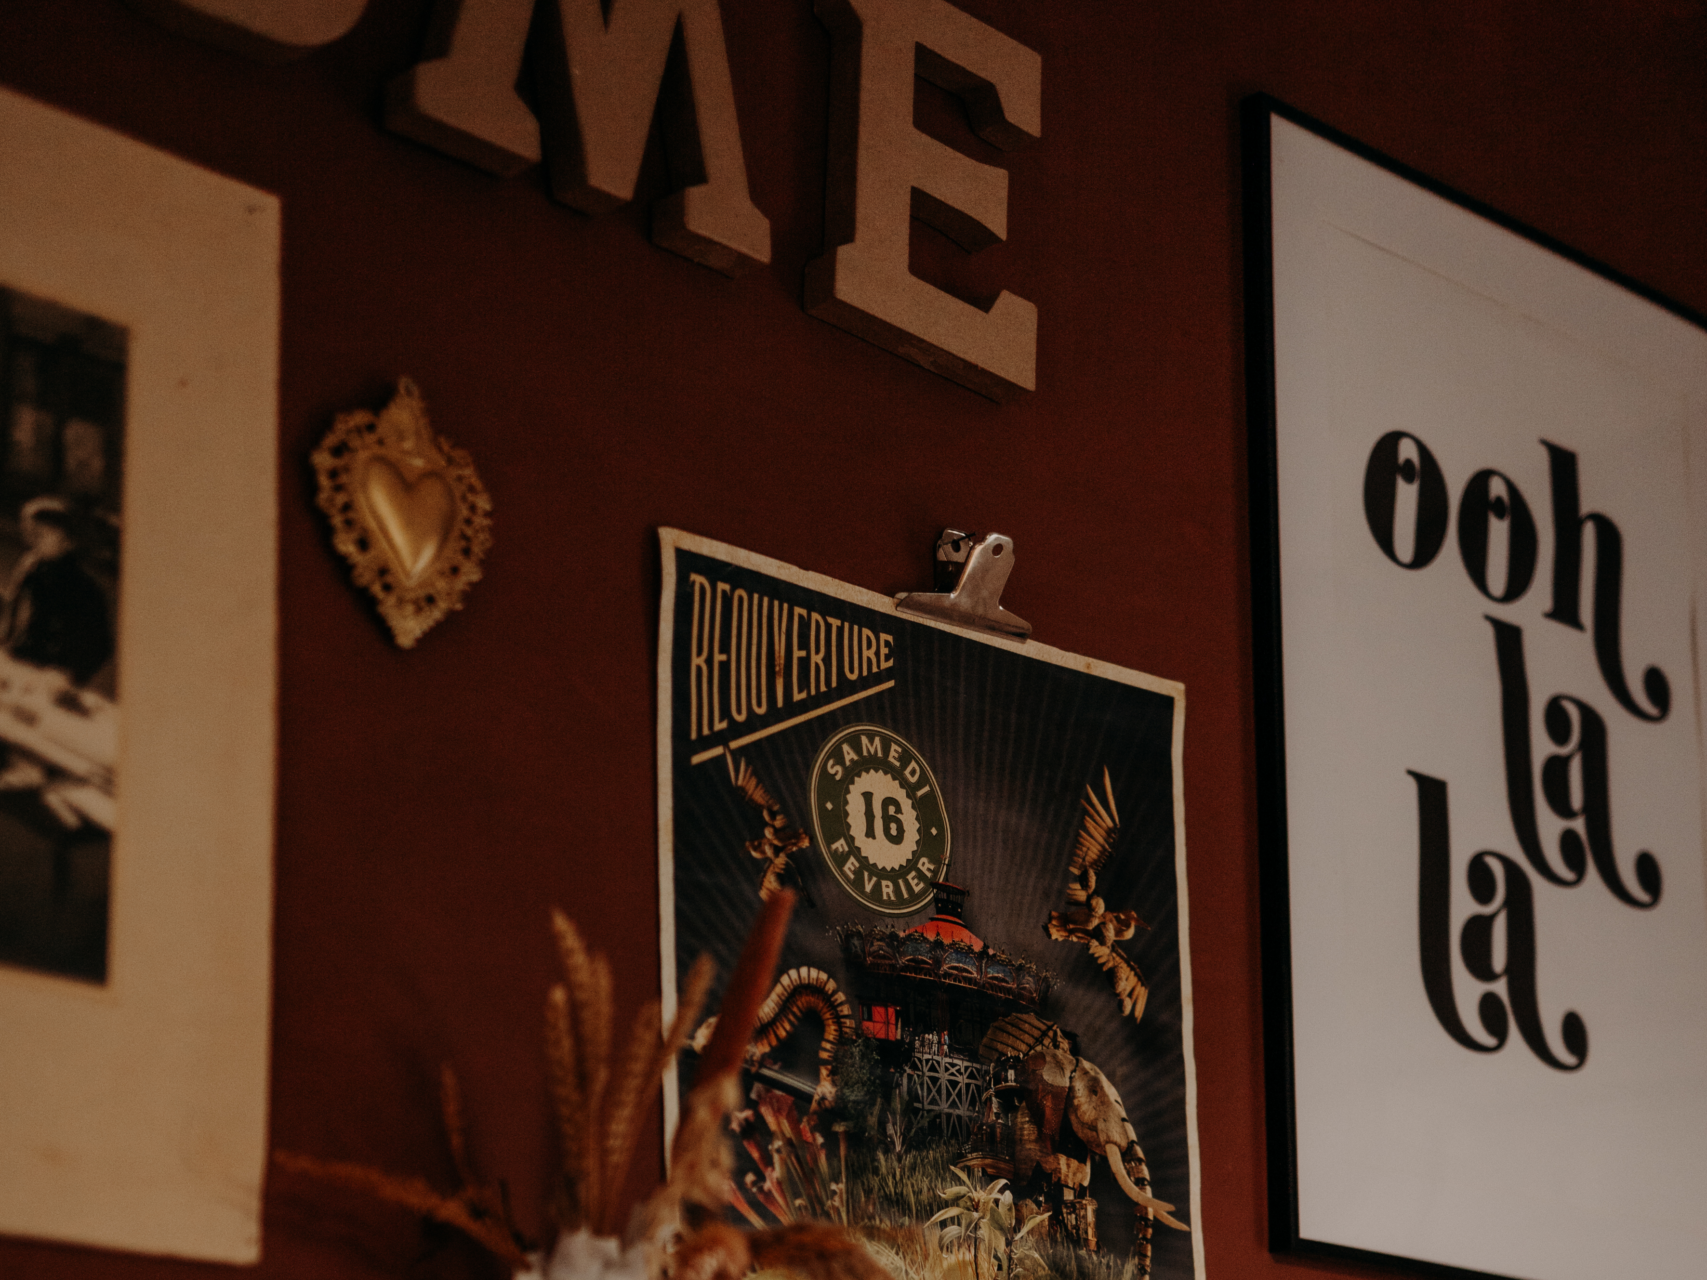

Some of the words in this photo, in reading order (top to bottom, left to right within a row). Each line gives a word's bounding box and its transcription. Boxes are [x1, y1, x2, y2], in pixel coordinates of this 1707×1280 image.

[178, 0, 1042, 392] ME
[690, 572, 894, 741] REOUVERTURE
[826, 734, 931, 800] SAMEDI
[860, 790, 906, 846] 16
[1482, 613, 1663, 911] la
[830, 836, 937, 901] FEVRIER
[1406, 769, 1589, 1073] la
